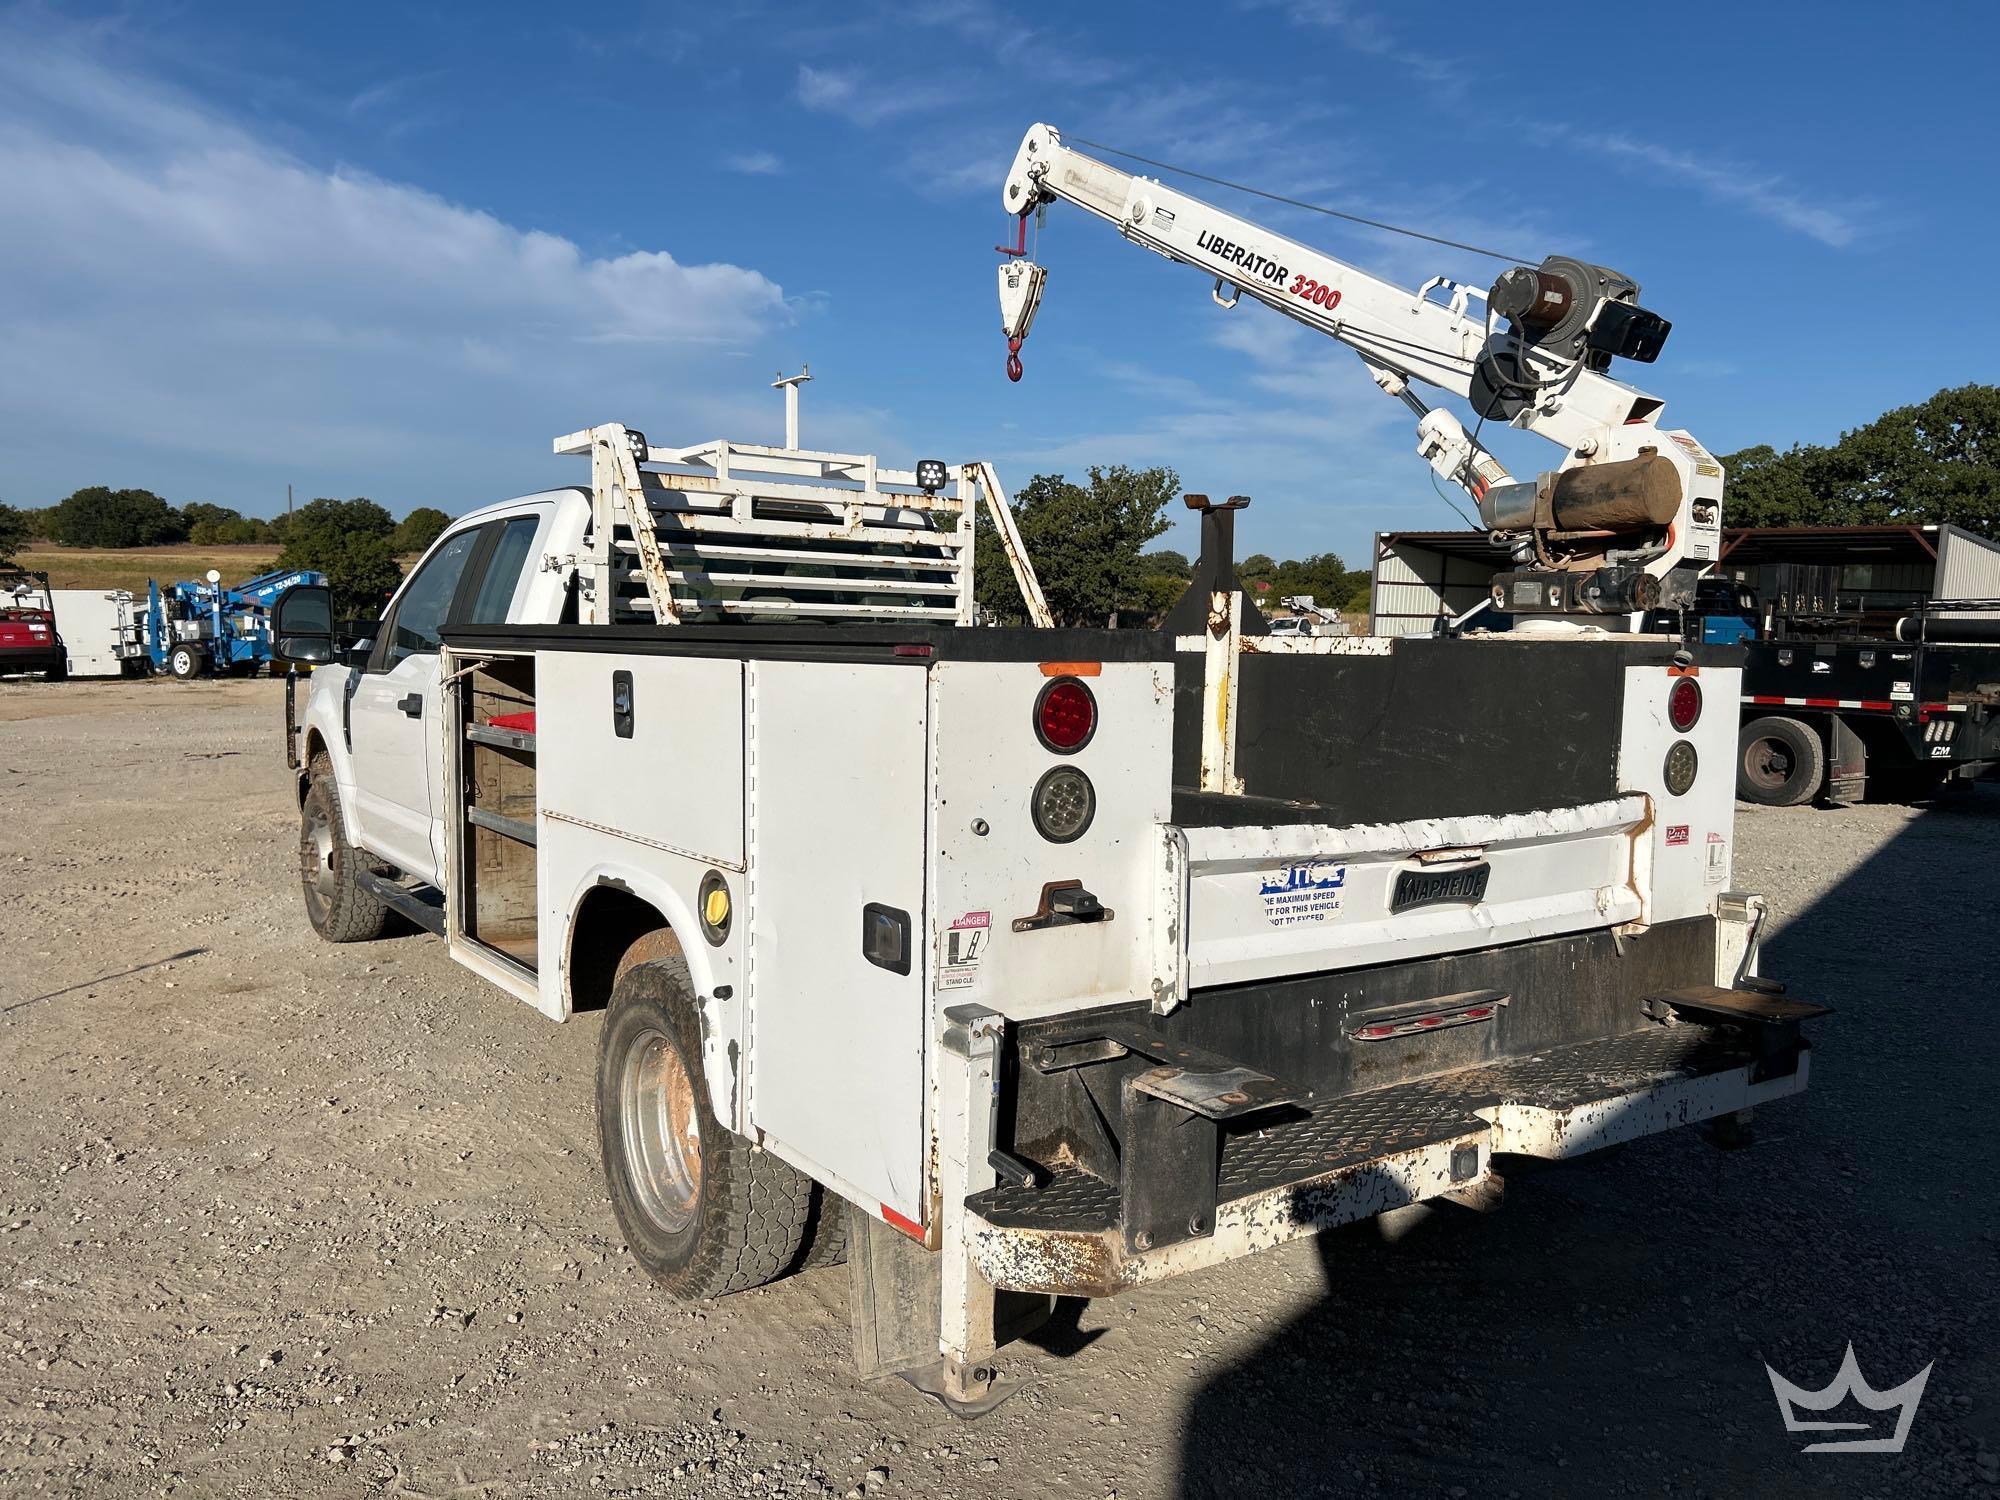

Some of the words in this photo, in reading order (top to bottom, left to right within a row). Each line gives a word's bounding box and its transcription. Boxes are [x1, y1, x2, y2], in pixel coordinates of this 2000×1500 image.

[1196, 230, 1289, 286] LIBERATOR
[1289, 274, 1342, 311] 3200
[1931, 746, 1951, 756] CM
[1396, 869, 1486, 907] KNAPHEIDE
[1276, 893, 1312, 904] MAXIMUM
[1312, 891, 1336, 901] SPEED
[1275, 906, 1290, 916] FOR
[1291, 904, 1309, 914] THIS
[1310, 901, 1340, 912] VEHICLE
[955, 915, 987, 926] DANGER
[945, 978, 963, 986] STAND
[963, 976, 975, 984] CLE
